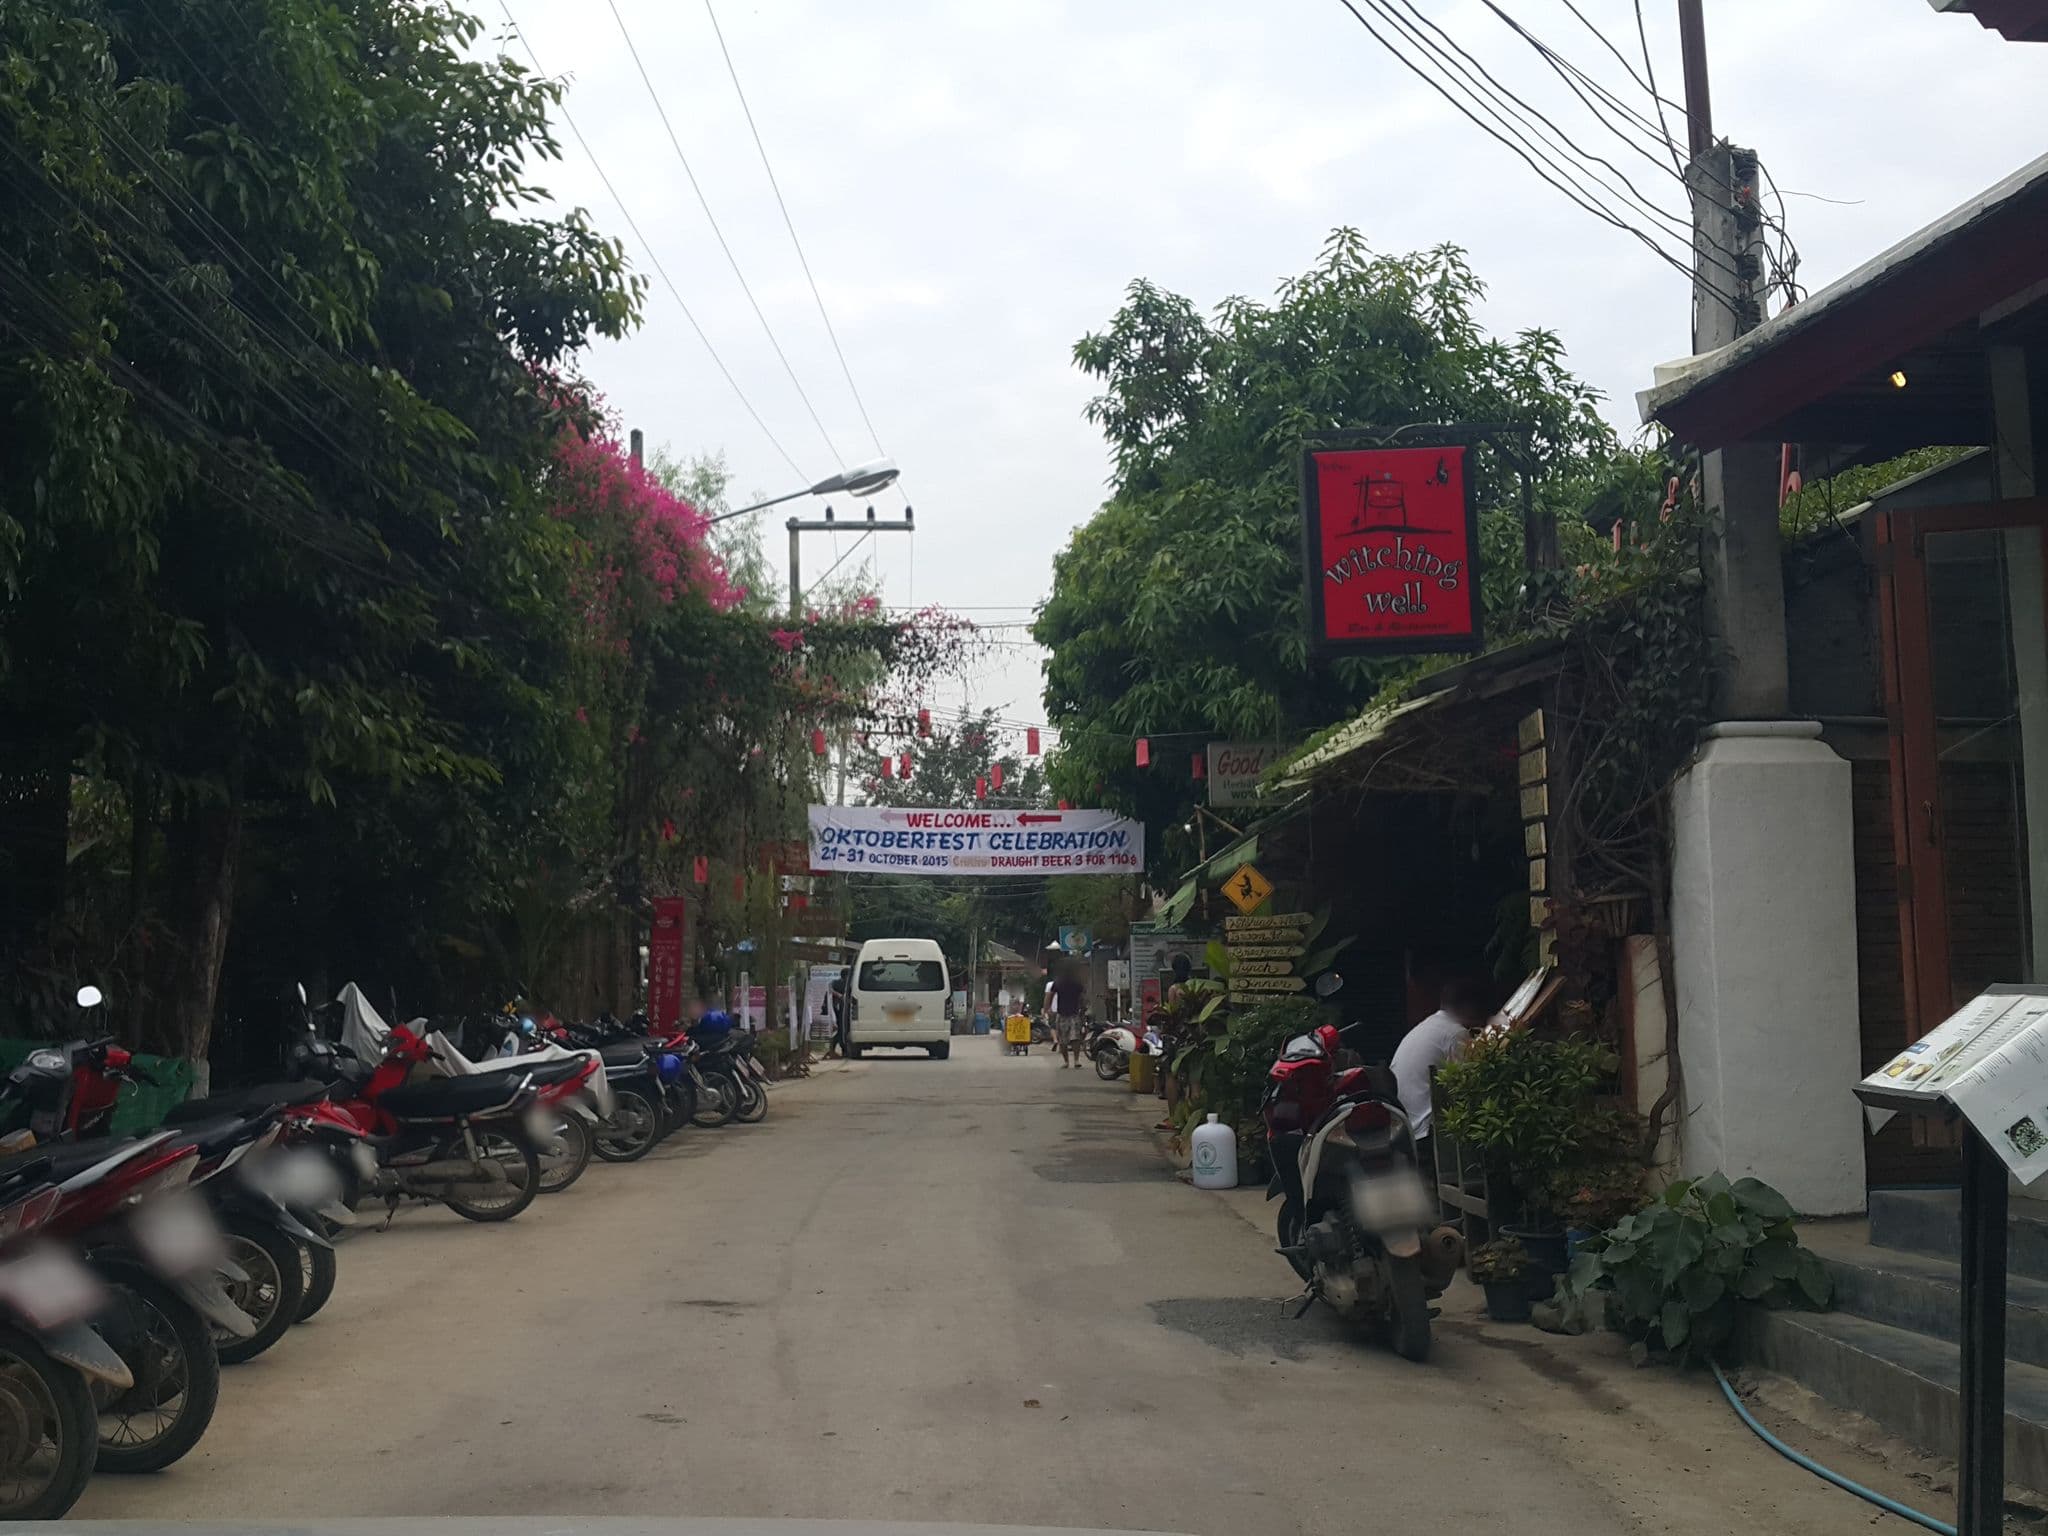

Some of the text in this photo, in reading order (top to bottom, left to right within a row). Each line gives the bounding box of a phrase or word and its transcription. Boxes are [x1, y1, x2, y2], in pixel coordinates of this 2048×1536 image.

[1216, 747, 1265, 776] Good
[821, 826, 1127, 851] OKTOBERFEST CELEBRATION
[821, 846, 865, 863] 21-31
[868, 852, 918, 866] OCTOBER
[921, 855, 949, 867] 2015
[990, 855, 1039, 868] DRAUGHT
[1041, 855, 1072, 867] BEER
[1074, 854, 1084, 866] 3
[1086, 853, 1106, 866] FOR
